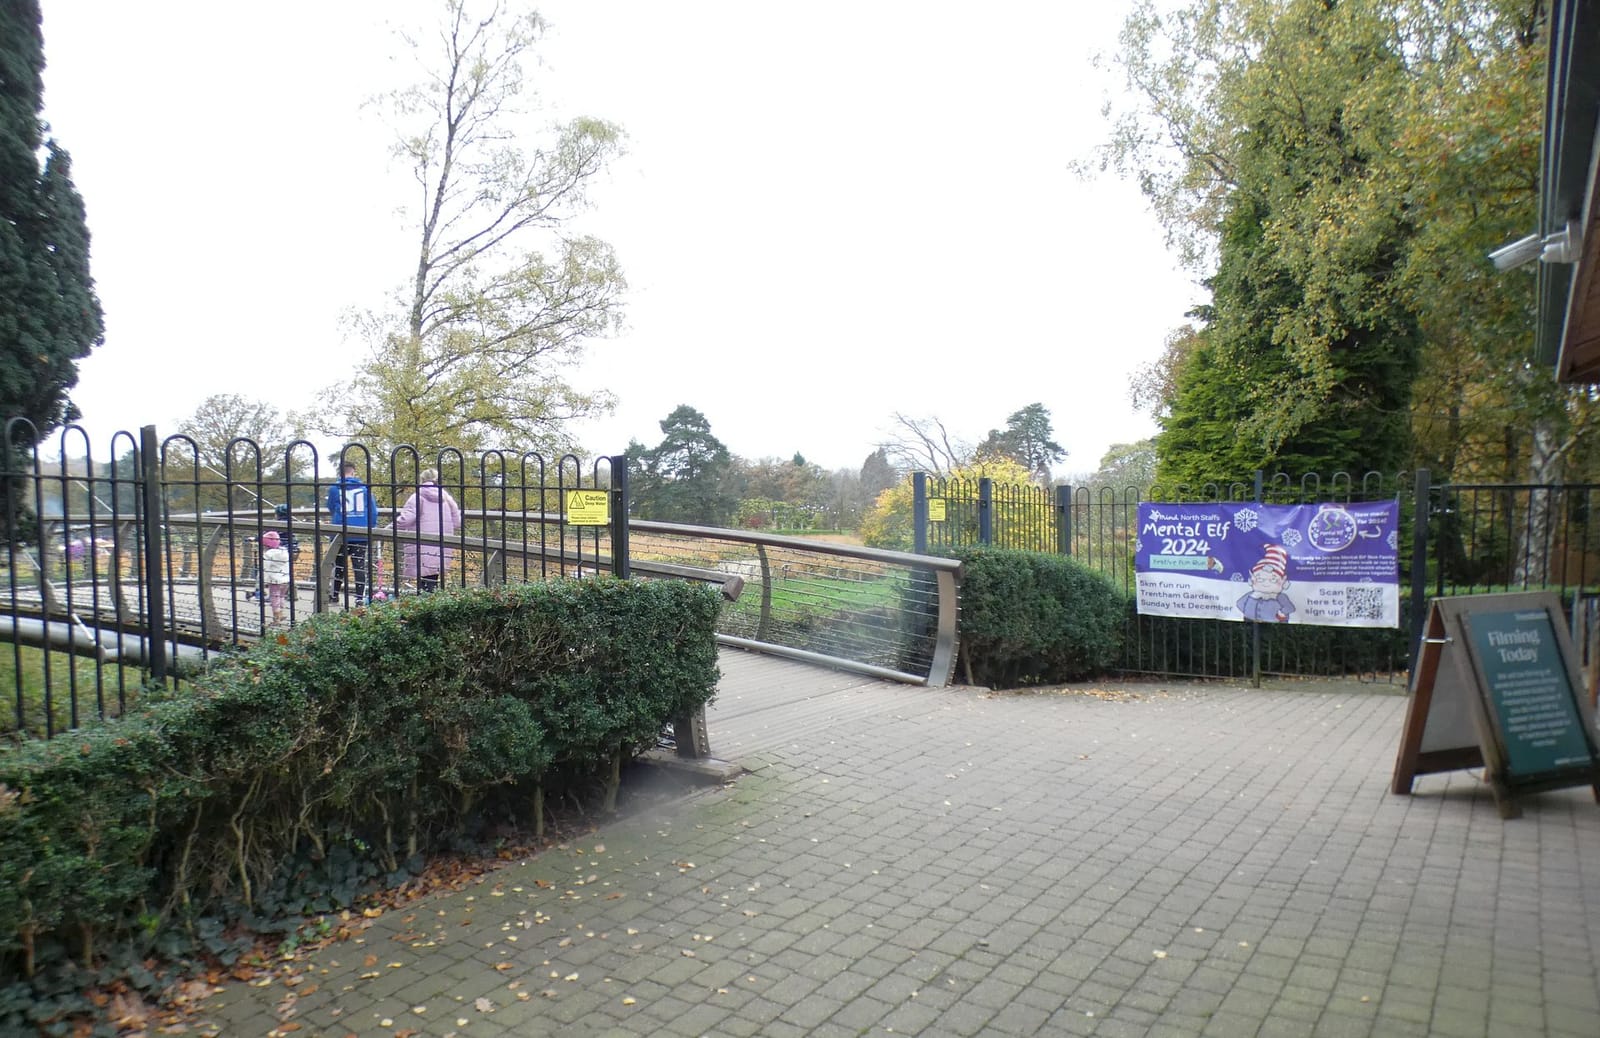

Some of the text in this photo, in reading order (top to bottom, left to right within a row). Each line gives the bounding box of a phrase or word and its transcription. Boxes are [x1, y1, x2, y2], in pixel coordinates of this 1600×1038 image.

[1143, 521, 1231, 541] Mental Elf
[1160, 538, 1211, 555] 2024
[1140, 580, 1157, 588] 5km
[1159, 580, 1174, 589] fun
[1140, 589, 1219, 601] Trentham Gardens
[1319, 588, 1344, 596] Scan
[1140, 599, 1234, 612] Sunday 1st December
[1307, 598, 1344, 606] here to
[1305, 607, 1344, 617] sign up!
[1487, 629, 1541, 647] Filming
[1498, 647, 1538, 663] Today
